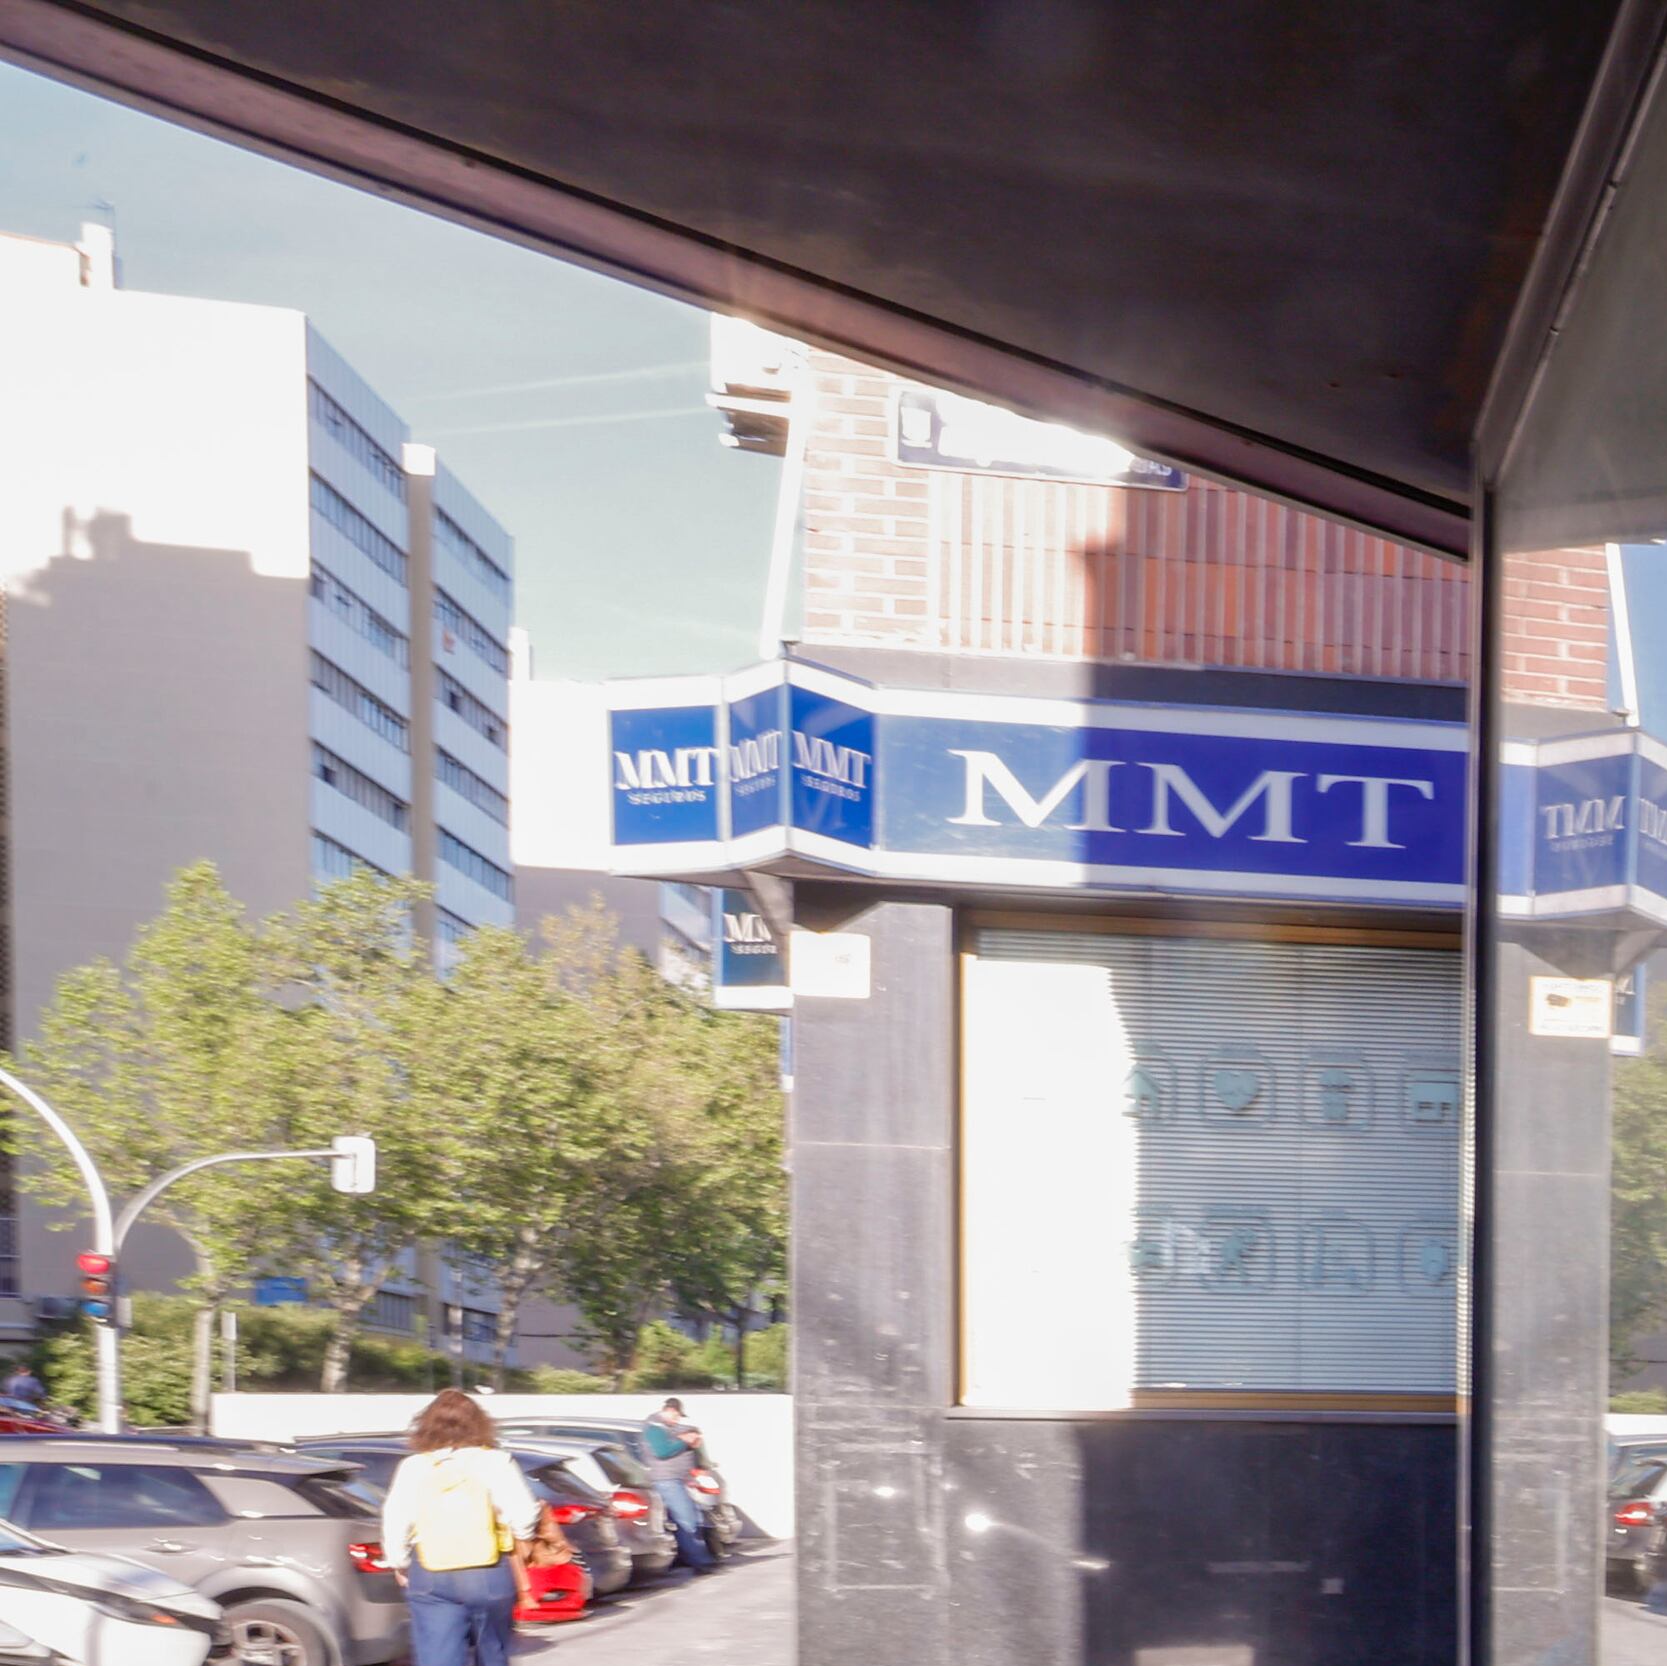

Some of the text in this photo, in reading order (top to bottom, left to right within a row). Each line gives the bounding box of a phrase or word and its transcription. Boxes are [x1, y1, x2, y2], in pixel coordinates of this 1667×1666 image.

[614, 747, 718, 789] MMT
[728, 729, 781, 782] MMT
[791, 730, 872, 788] MMT
[627, 789, 707, 805] SEGUROS
[946, 749, 1435, 849] MMT
